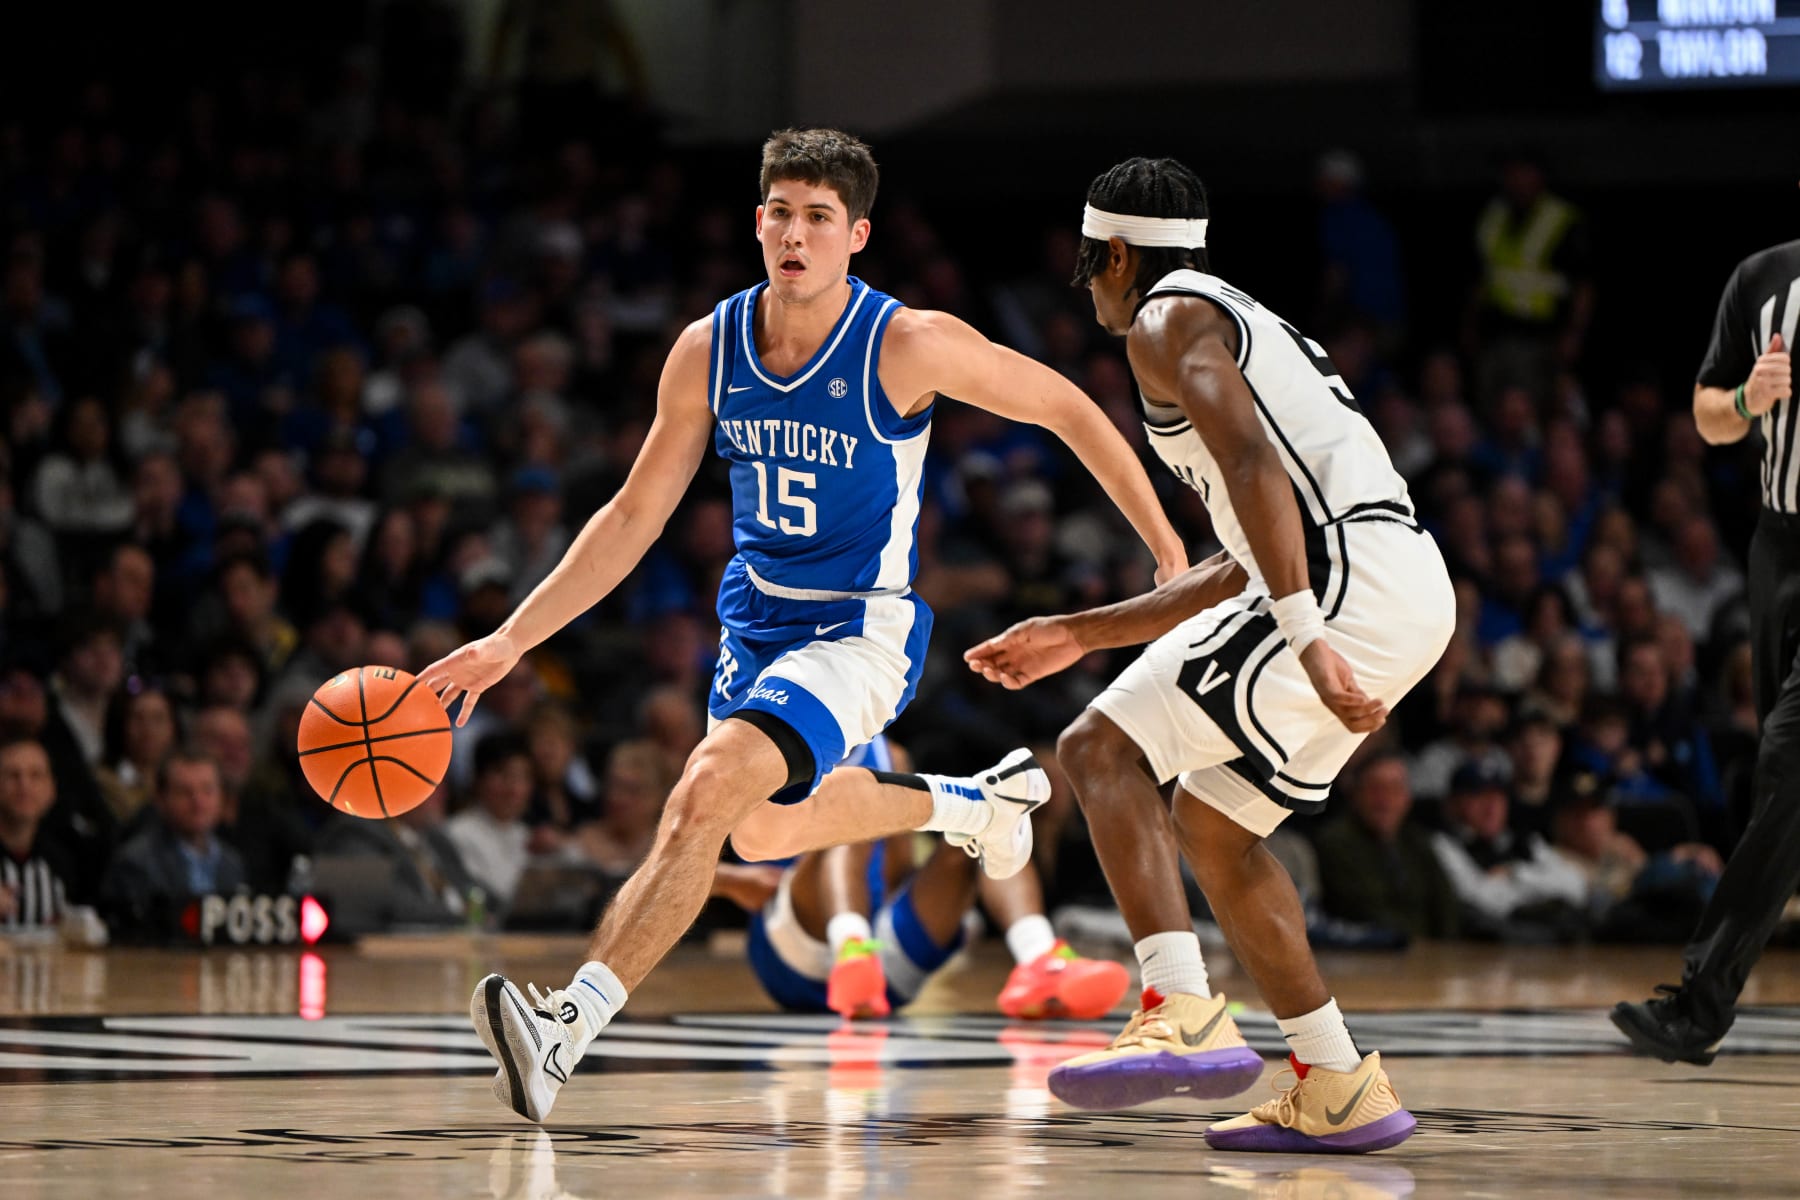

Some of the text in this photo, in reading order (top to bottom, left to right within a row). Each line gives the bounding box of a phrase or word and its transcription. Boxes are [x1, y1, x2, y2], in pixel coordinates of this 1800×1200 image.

[1657, 28, 1767, 77] TAYLOR
[830, 379, 846, 397] SEC
[720, 420, 858, 469] KENTUCKY
[752, 461, 817, 537] 15
[1196, 659, 1231, 696] V
[202, 895, 298, 943] POSS
[607, 1108, 1606, 1137] Mmorial
[461, 1135, 1133, 1158] Court
